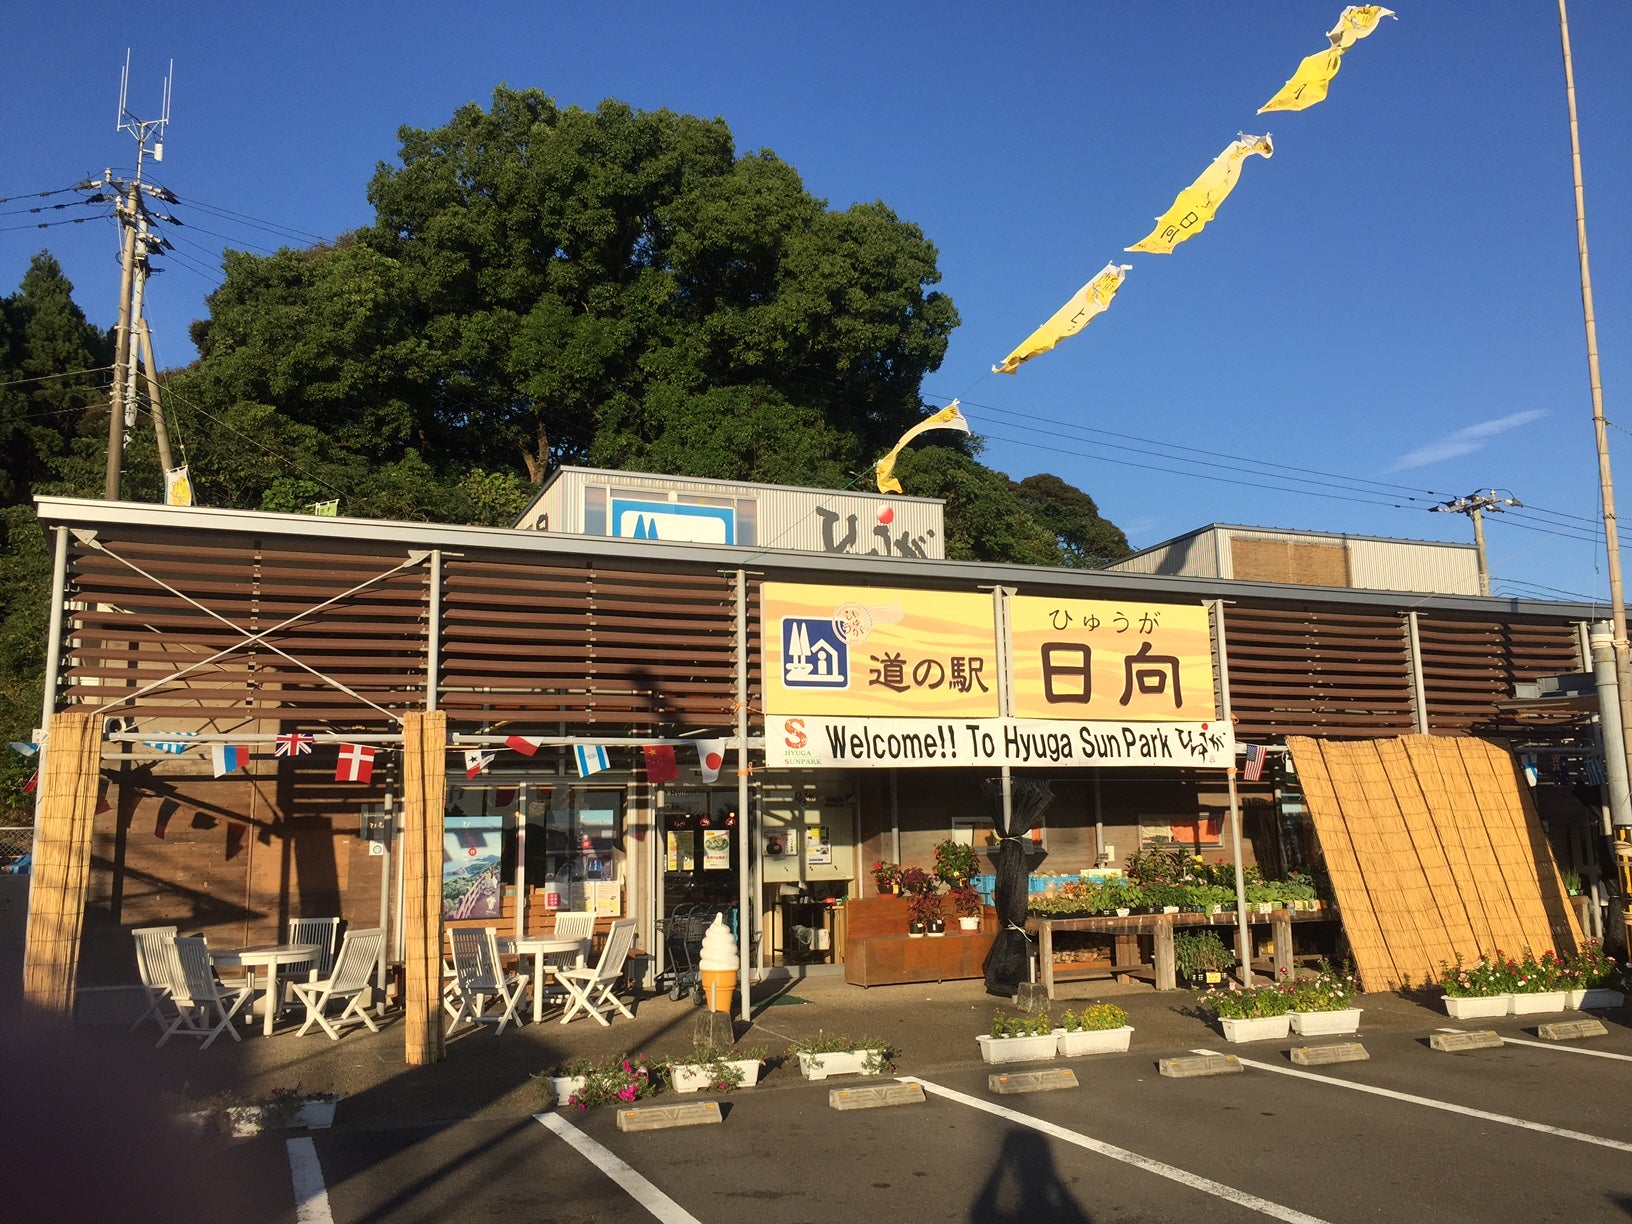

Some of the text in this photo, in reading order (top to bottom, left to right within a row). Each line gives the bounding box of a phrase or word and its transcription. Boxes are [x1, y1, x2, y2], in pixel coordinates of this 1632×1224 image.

[1048, 609, 1161, 635] ひゅうが
[868, 651, 989, 693] 道の駅
[1041, 641, 1183, 709] 日向
[825, 724, 957, 759] Welcome!!
[966, 724, 995, 758] To
[1003, 725, 1073, 762] Hyuga
